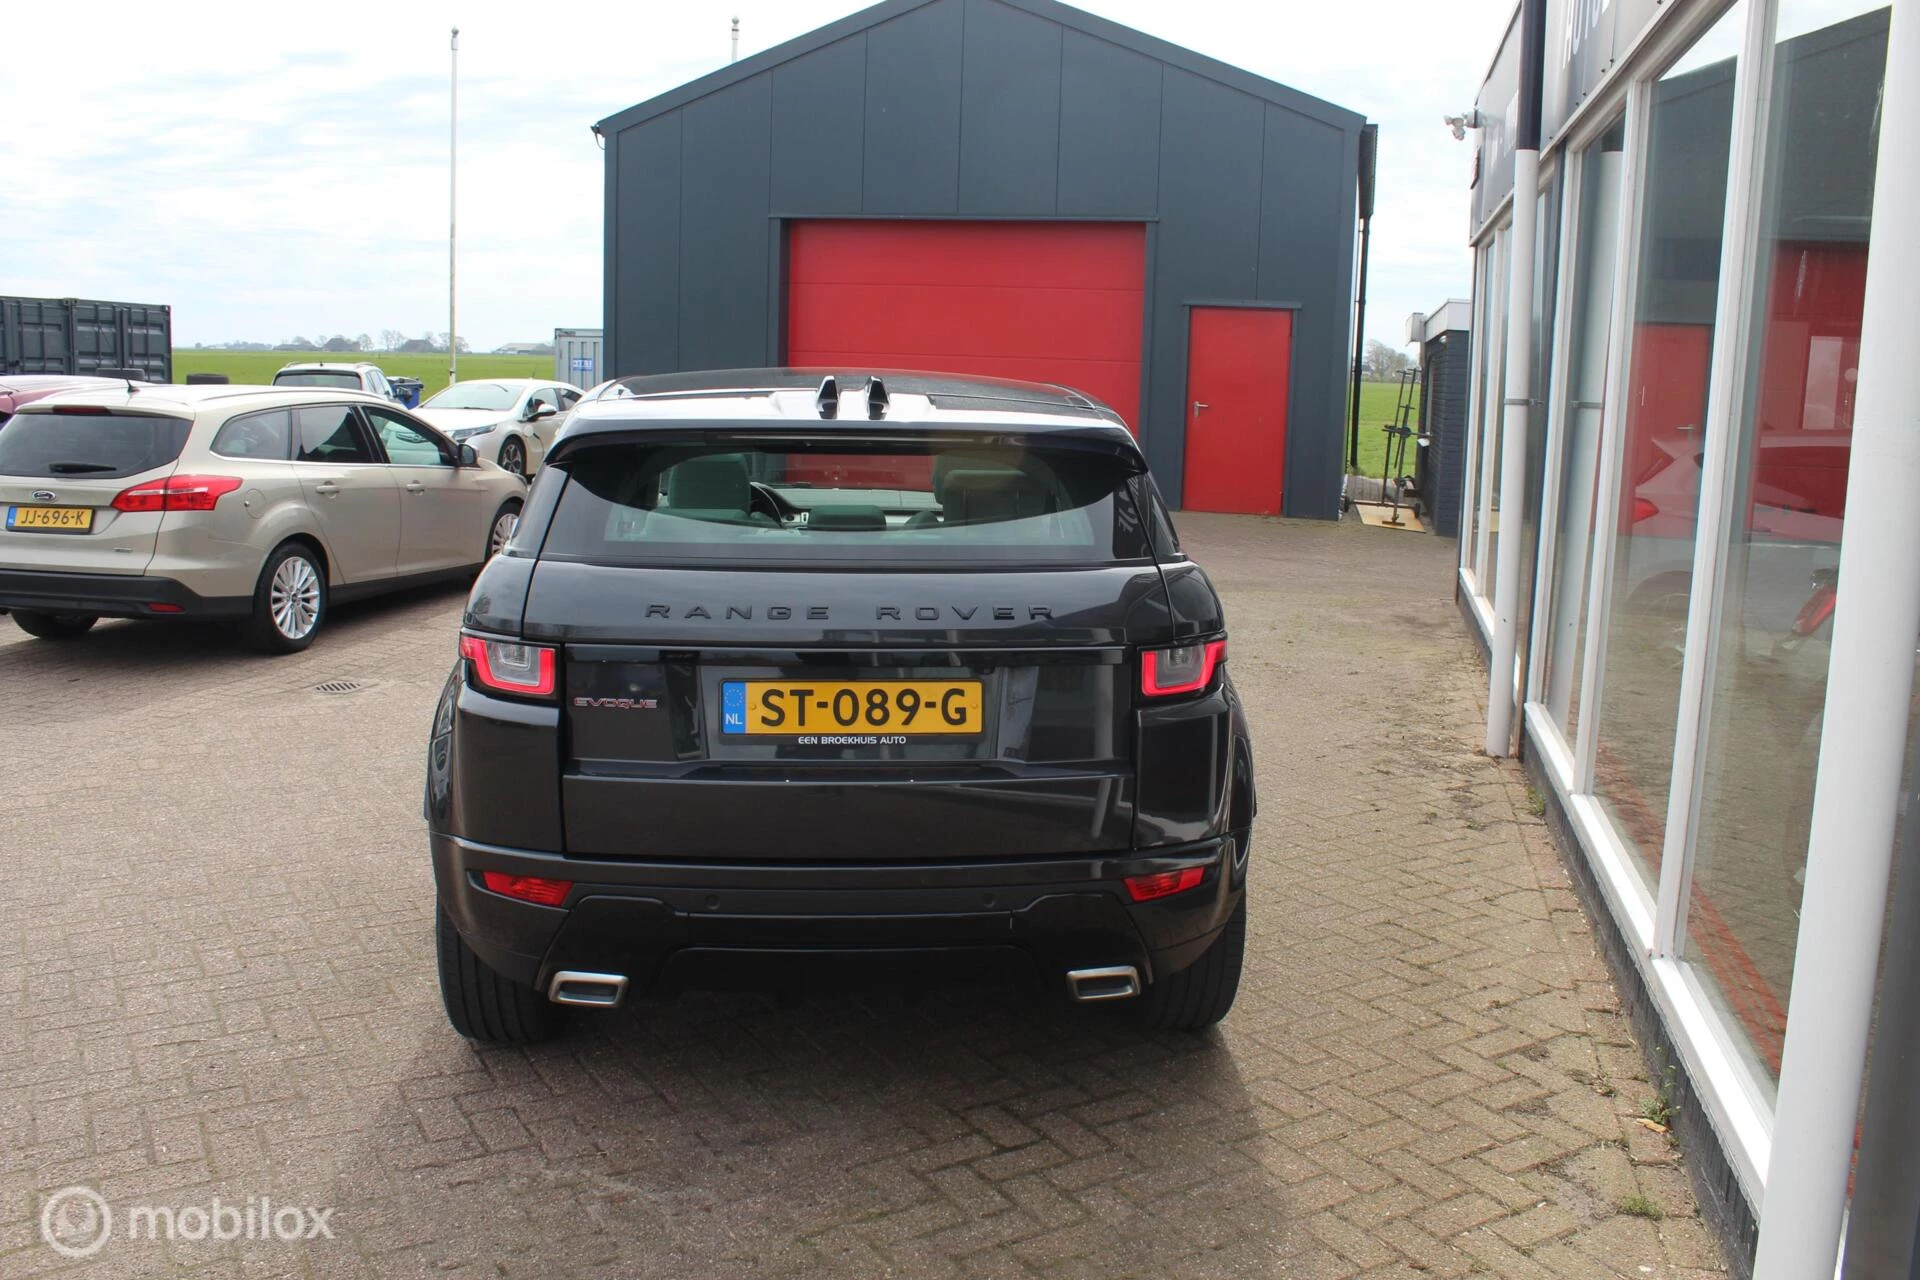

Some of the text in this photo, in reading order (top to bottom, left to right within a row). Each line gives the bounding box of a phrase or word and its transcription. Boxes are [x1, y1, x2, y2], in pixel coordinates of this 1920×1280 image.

[20, 510, 84, 525] JJ-696-K
[644, 604, 1053, 621] RANGE ROVER
[574, 697, 657, 709] EVOQUE
[760, 688, 967, 727] ST-089-G
[725, 713, 743, 725] NL
[798, 736, 906, 745] EEN BROEKHUIS AUTO
